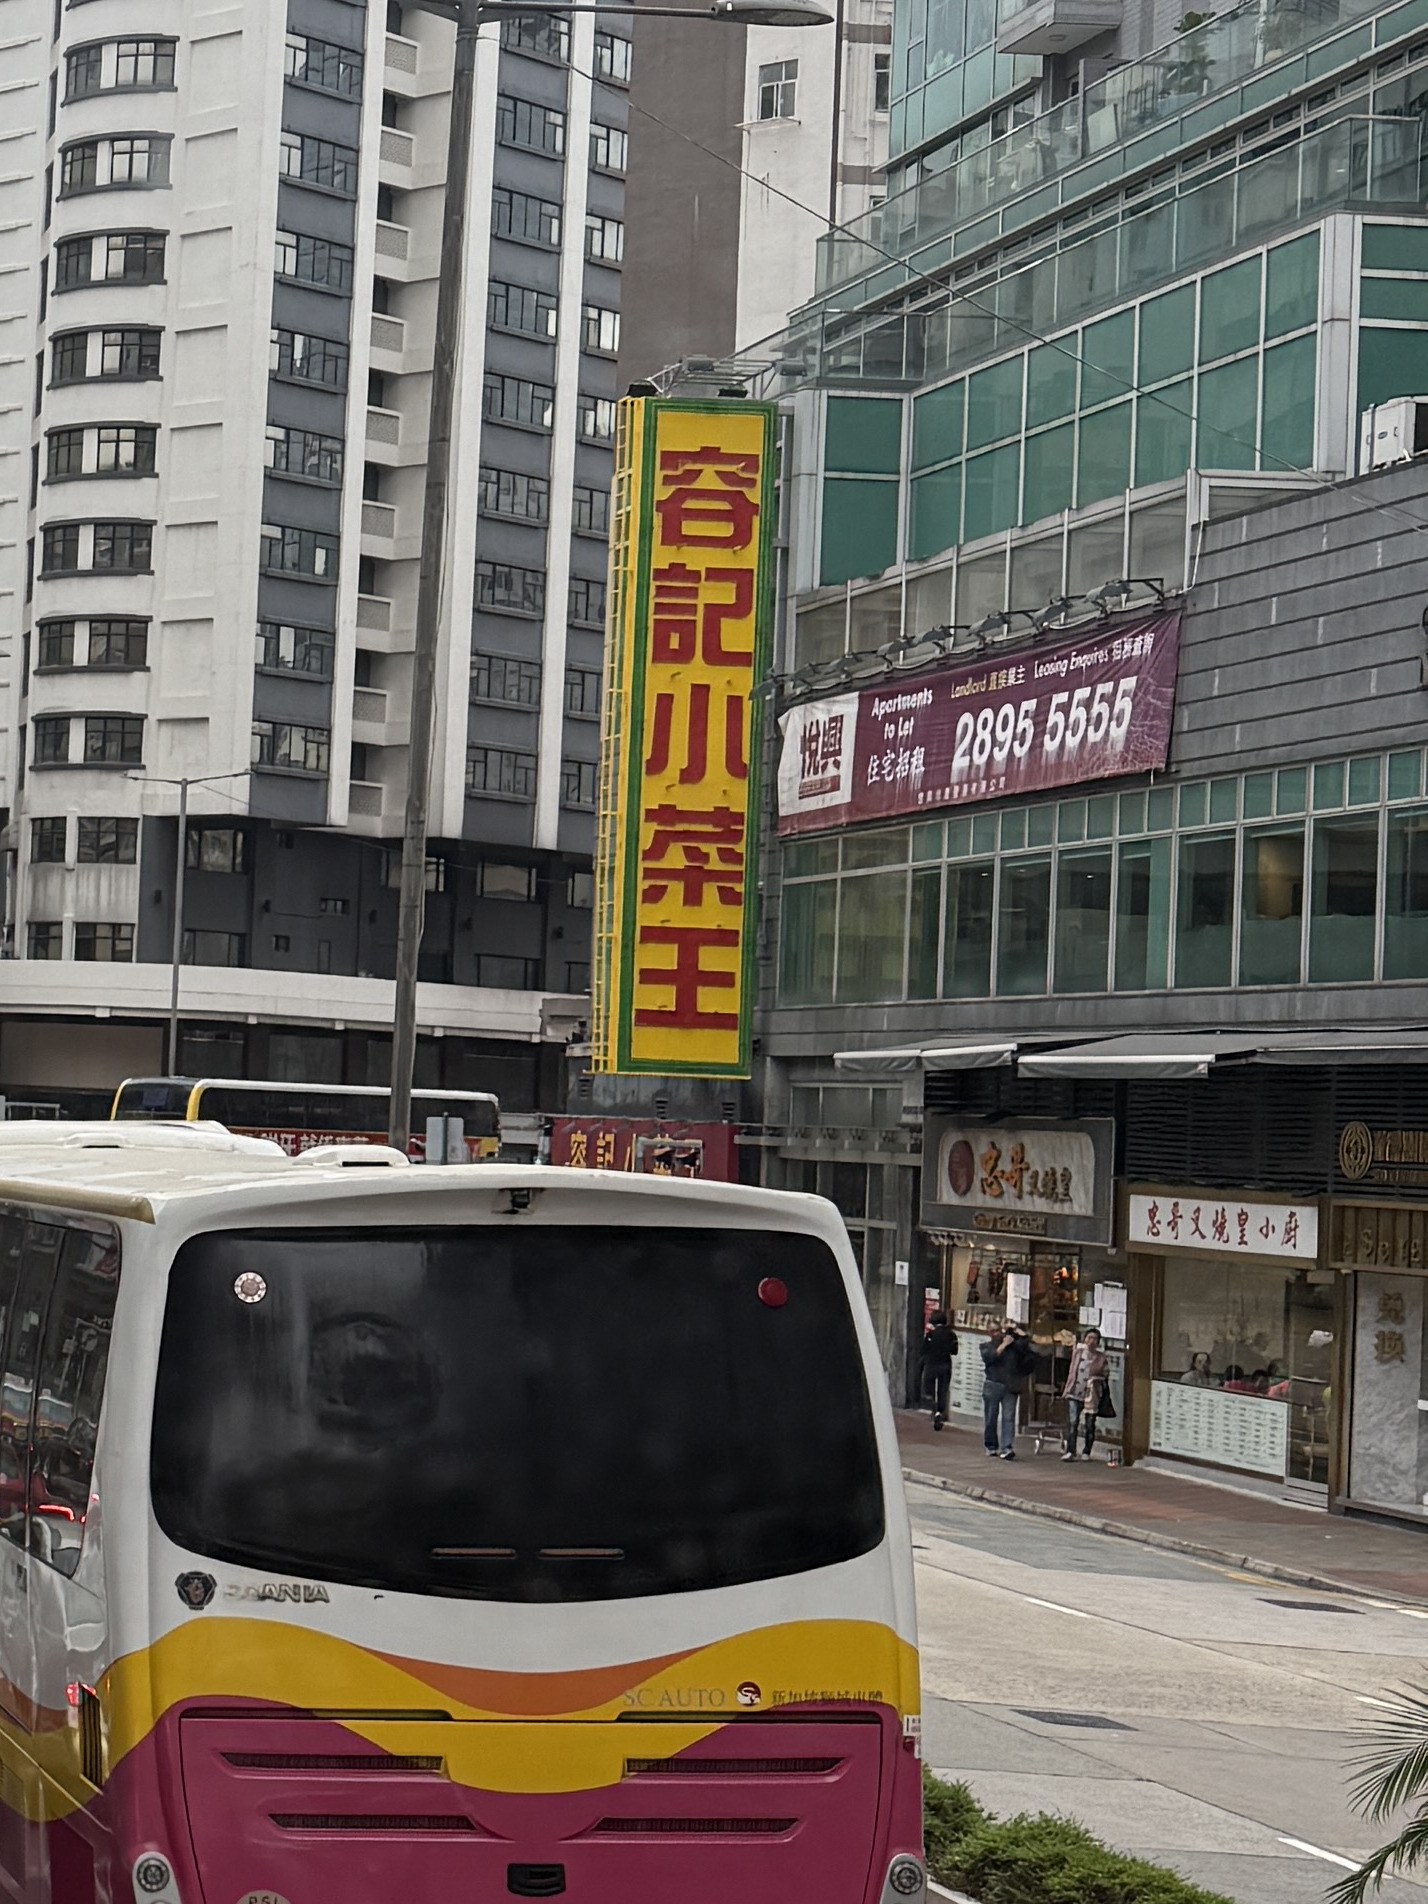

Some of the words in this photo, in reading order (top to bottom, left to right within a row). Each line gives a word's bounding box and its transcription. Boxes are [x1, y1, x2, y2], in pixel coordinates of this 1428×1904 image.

[1034, 657, 1067, 679] Leasing
[872, 688, 933, 720] Apartments
[898, 717, 914, 737] Let
[951, 699, 1037, 772] 2895
[1044, 676, 1138, 753] 5555
[633, 446, 760, 1031] 容記小菜王
[623, 1688, 654, 1708] SC
[657, 1688, 726, 1708] AUTO
